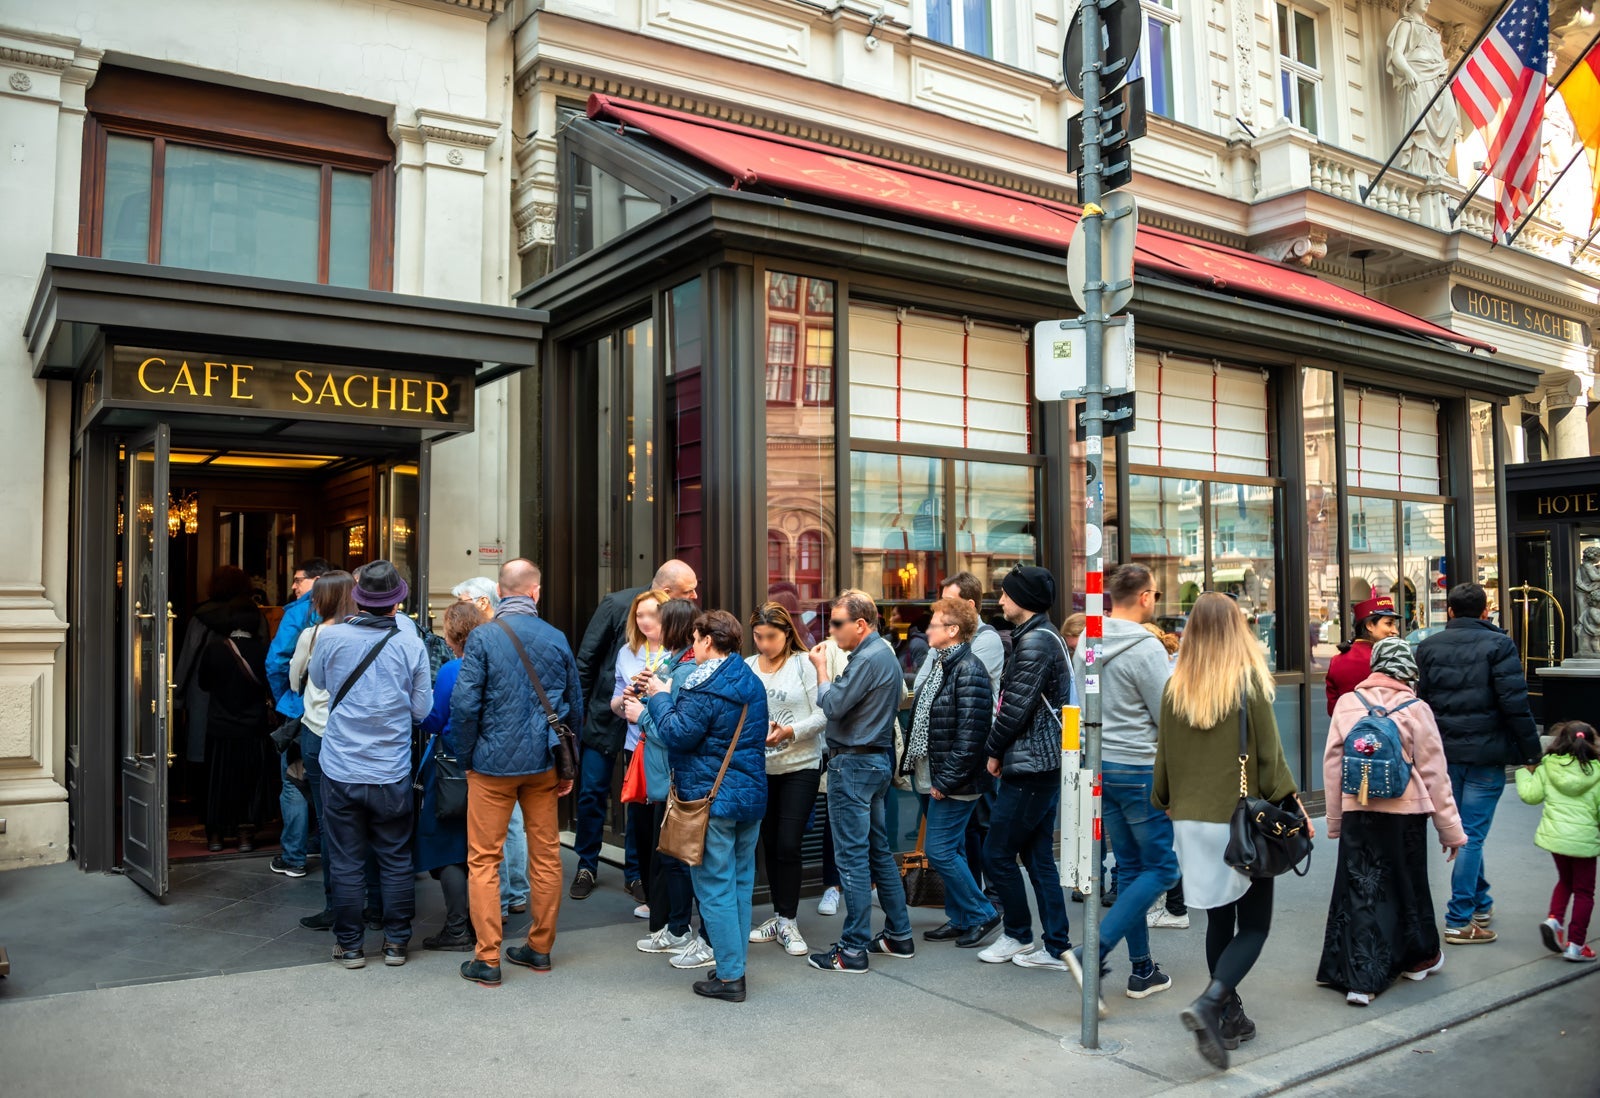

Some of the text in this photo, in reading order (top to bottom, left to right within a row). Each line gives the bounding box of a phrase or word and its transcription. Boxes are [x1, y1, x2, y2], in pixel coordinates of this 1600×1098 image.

[1468, 291, 1582, 341] HOTEL SACHER
[137, 357, 449, 415] CAFE SACHER
[1537, 493, 1598, 514] HOTE
